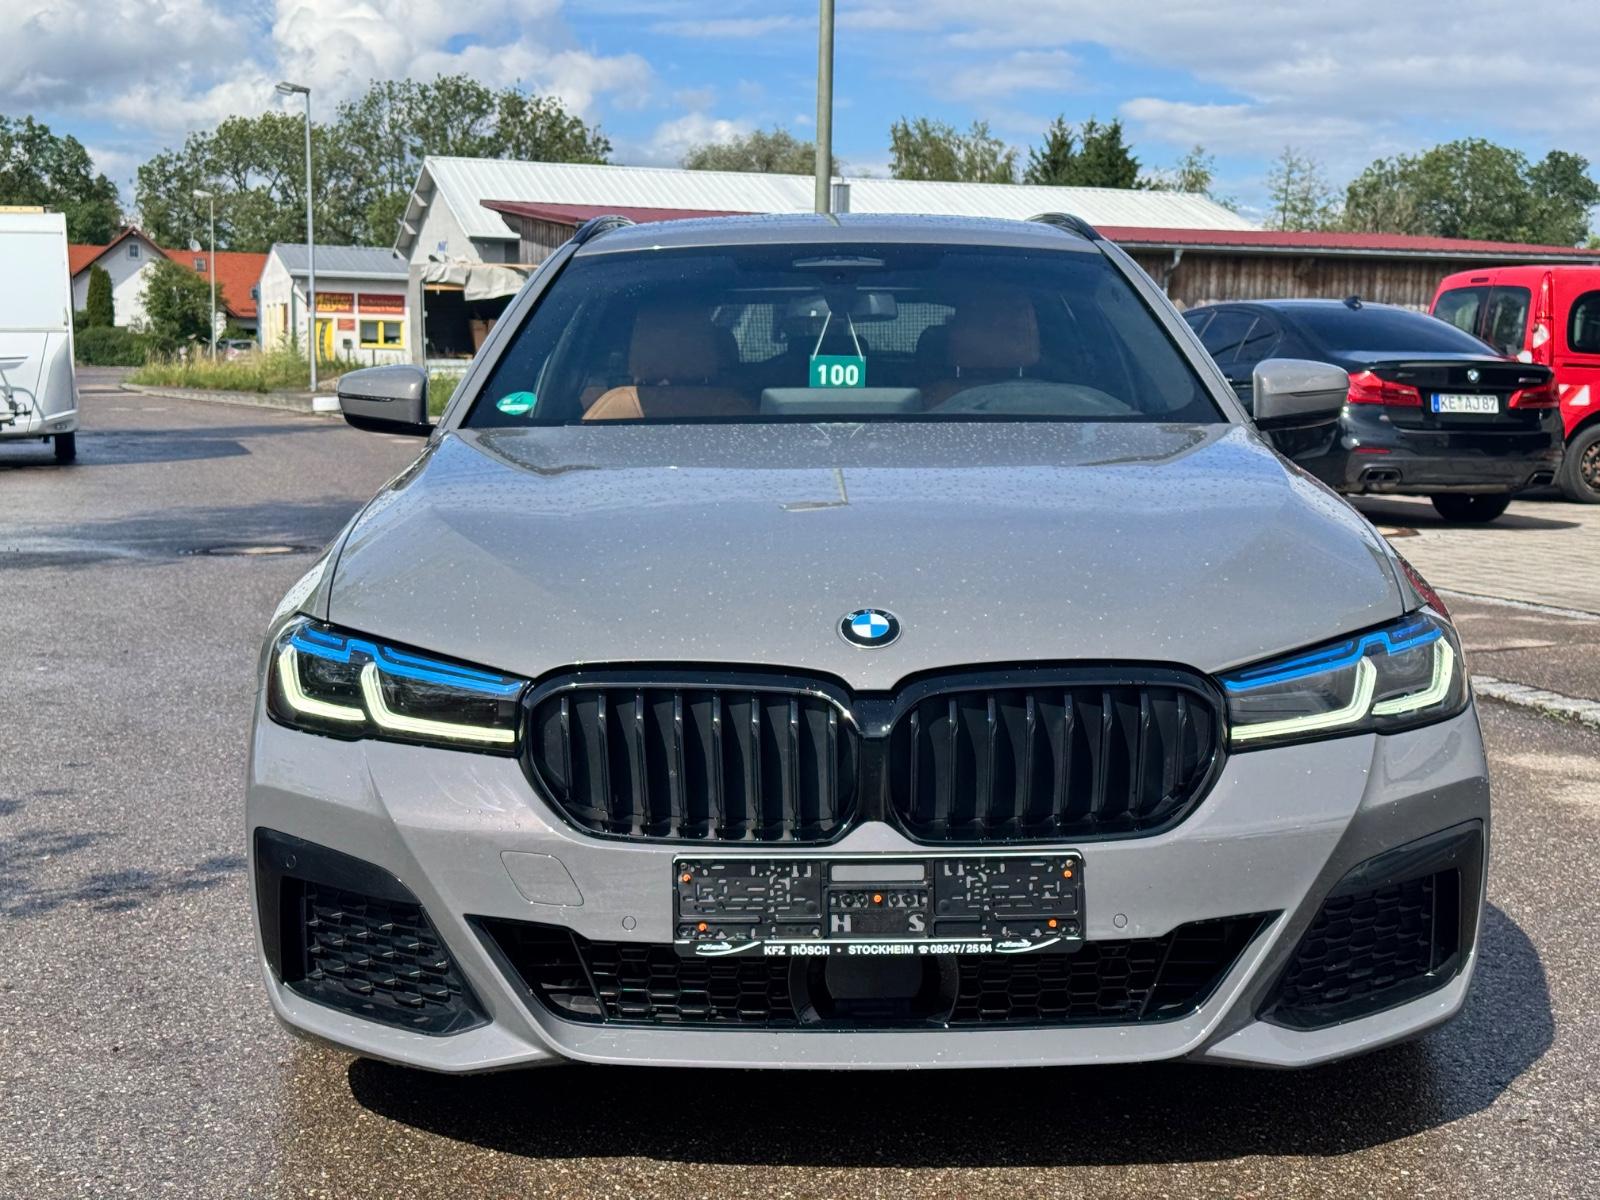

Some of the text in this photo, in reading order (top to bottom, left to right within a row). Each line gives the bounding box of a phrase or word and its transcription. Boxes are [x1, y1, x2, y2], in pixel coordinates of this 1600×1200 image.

[818, 364, 859, 386] 100
[1440, 395, 1456, 410] KE
[763, 945, 786, 956] KFZ
[791, 943, 831, 956] RÖSCH
[848, 944, 914, 955] STOCKHEIM
